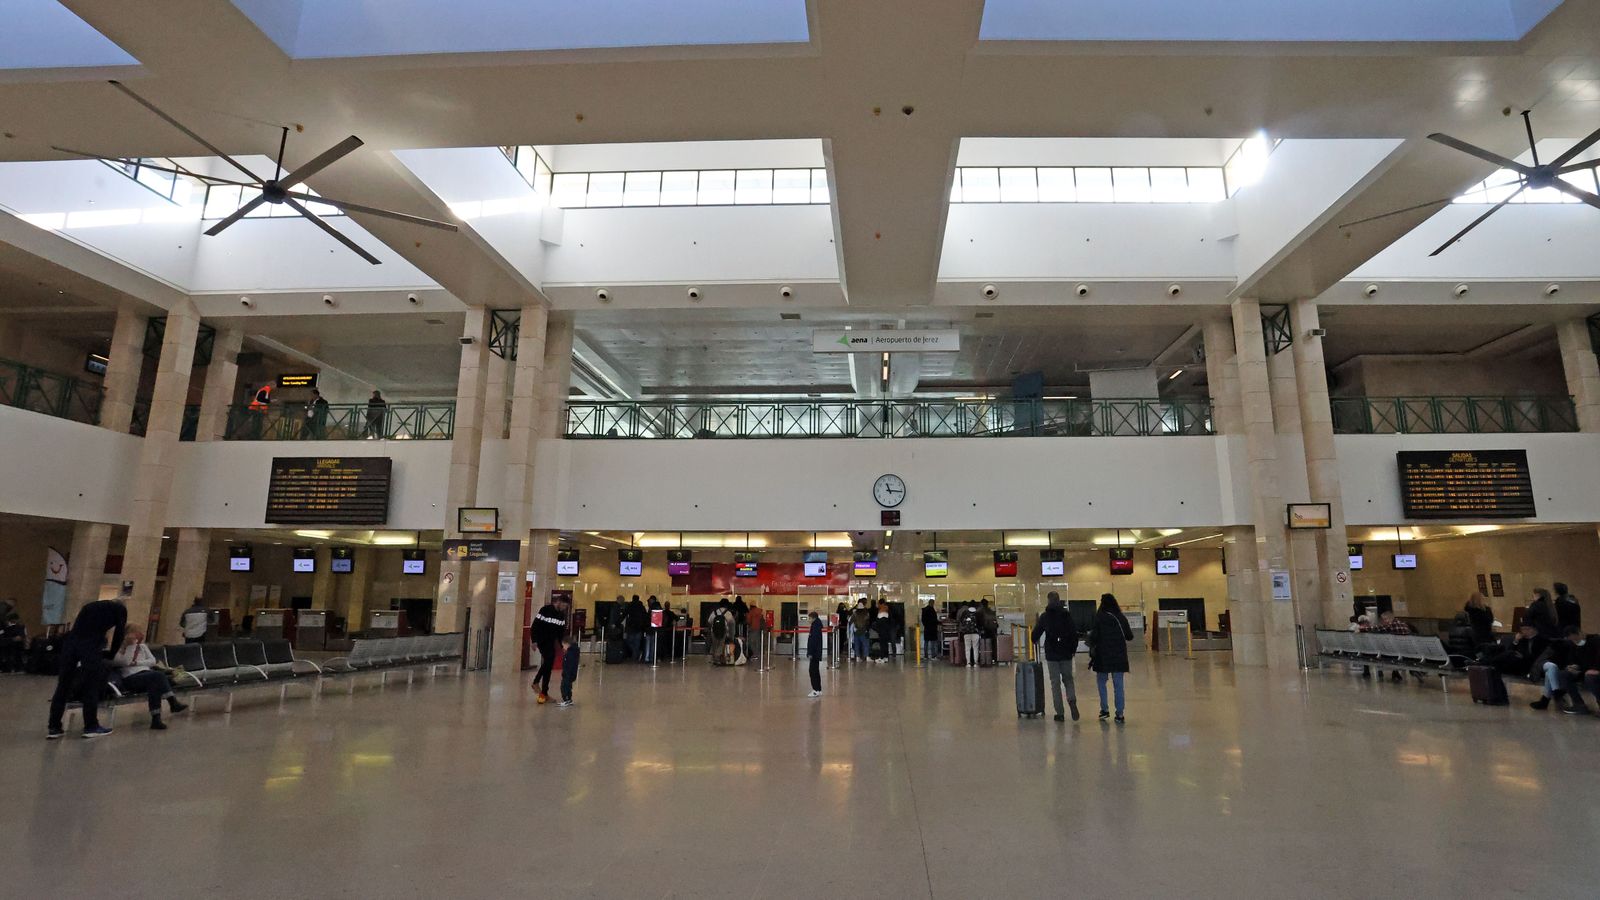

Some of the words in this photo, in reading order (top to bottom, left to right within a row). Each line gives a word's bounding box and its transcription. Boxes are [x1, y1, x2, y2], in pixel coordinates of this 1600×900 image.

[875, 336, 912, 344] Aeropuerto
[922, 336, 939, 344] Jerez
[1116, 550, 1127, 558] 16
[1162, 550, 1172, 558] 17
